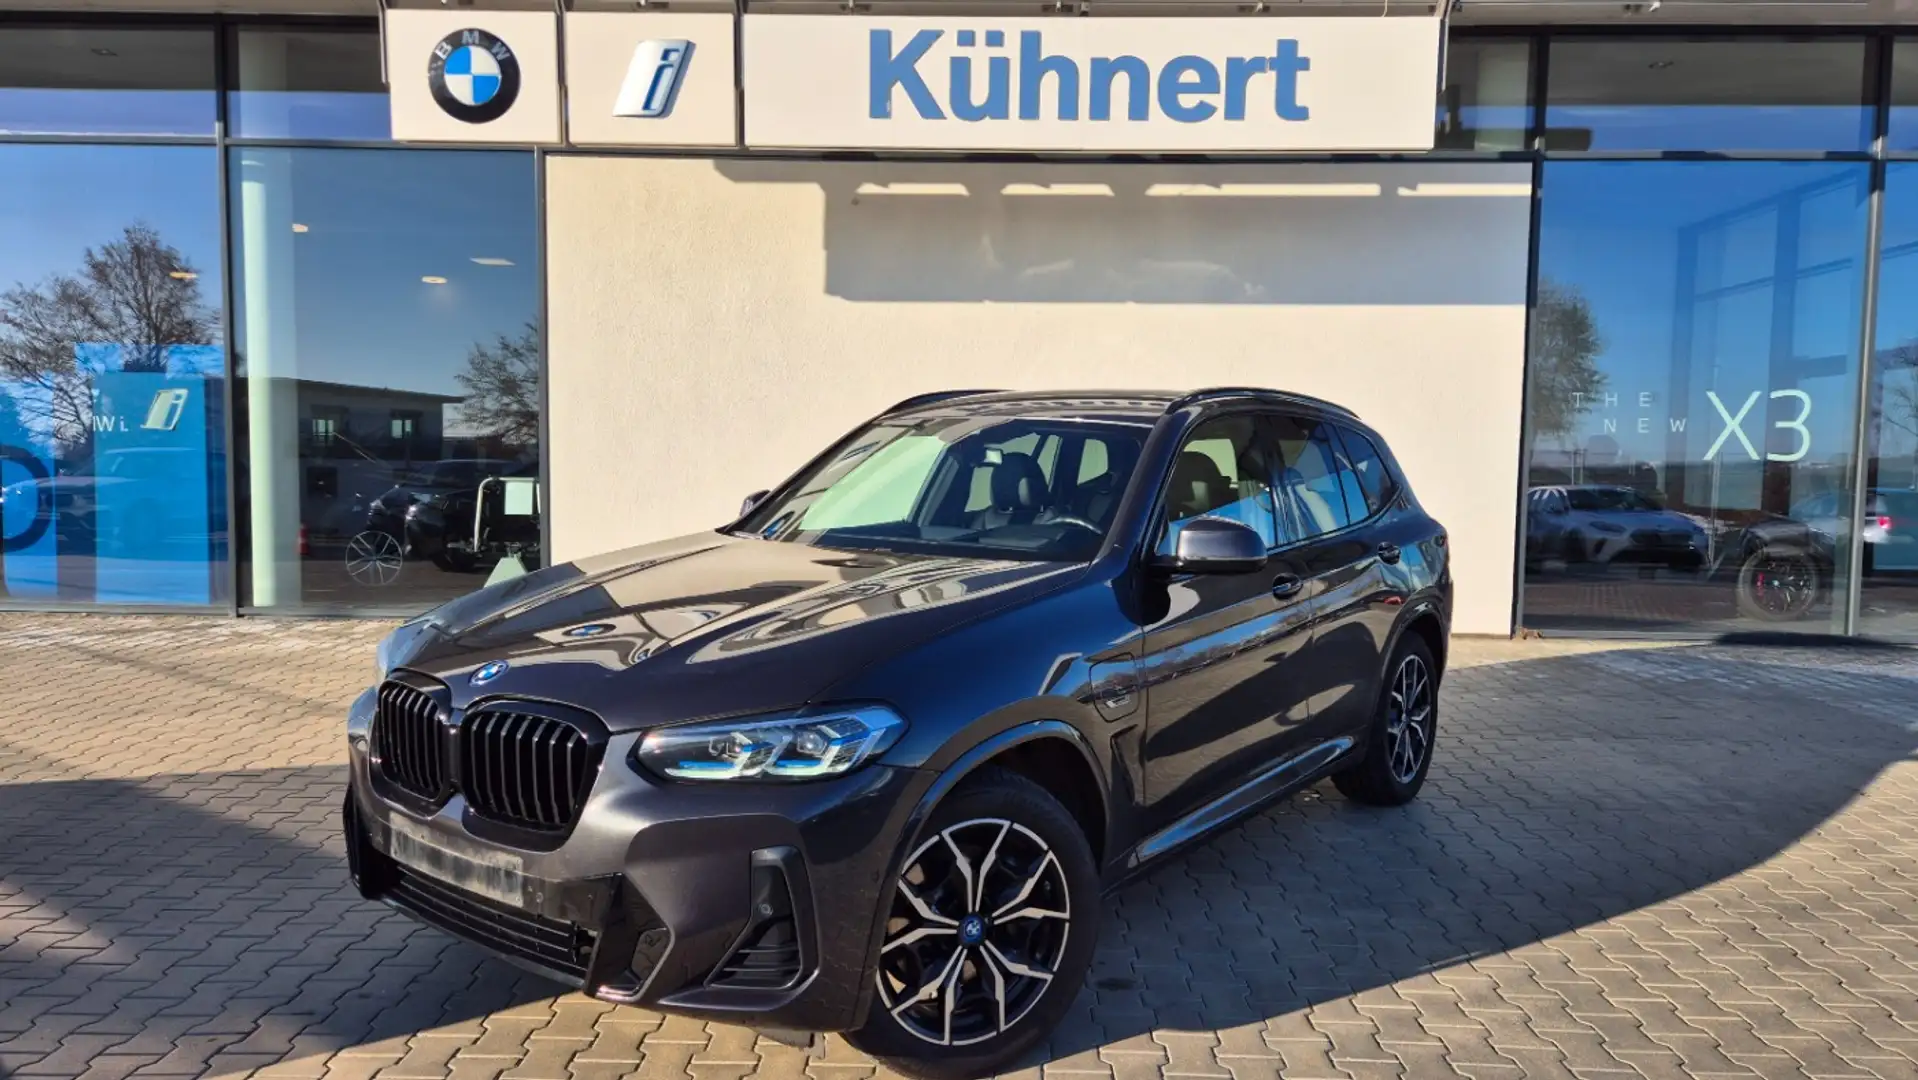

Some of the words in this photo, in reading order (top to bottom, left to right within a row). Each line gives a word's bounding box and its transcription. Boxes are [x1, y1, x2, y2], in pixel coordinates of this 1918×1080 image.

[435, 30, 511, 61] BMW
[869, 28, 1311, 123] Kühnert
[1571, 391, 1652, 408] THE
[1604, 418, 1687, 433] NEW
[1702, 388, 1812, 462] X3
